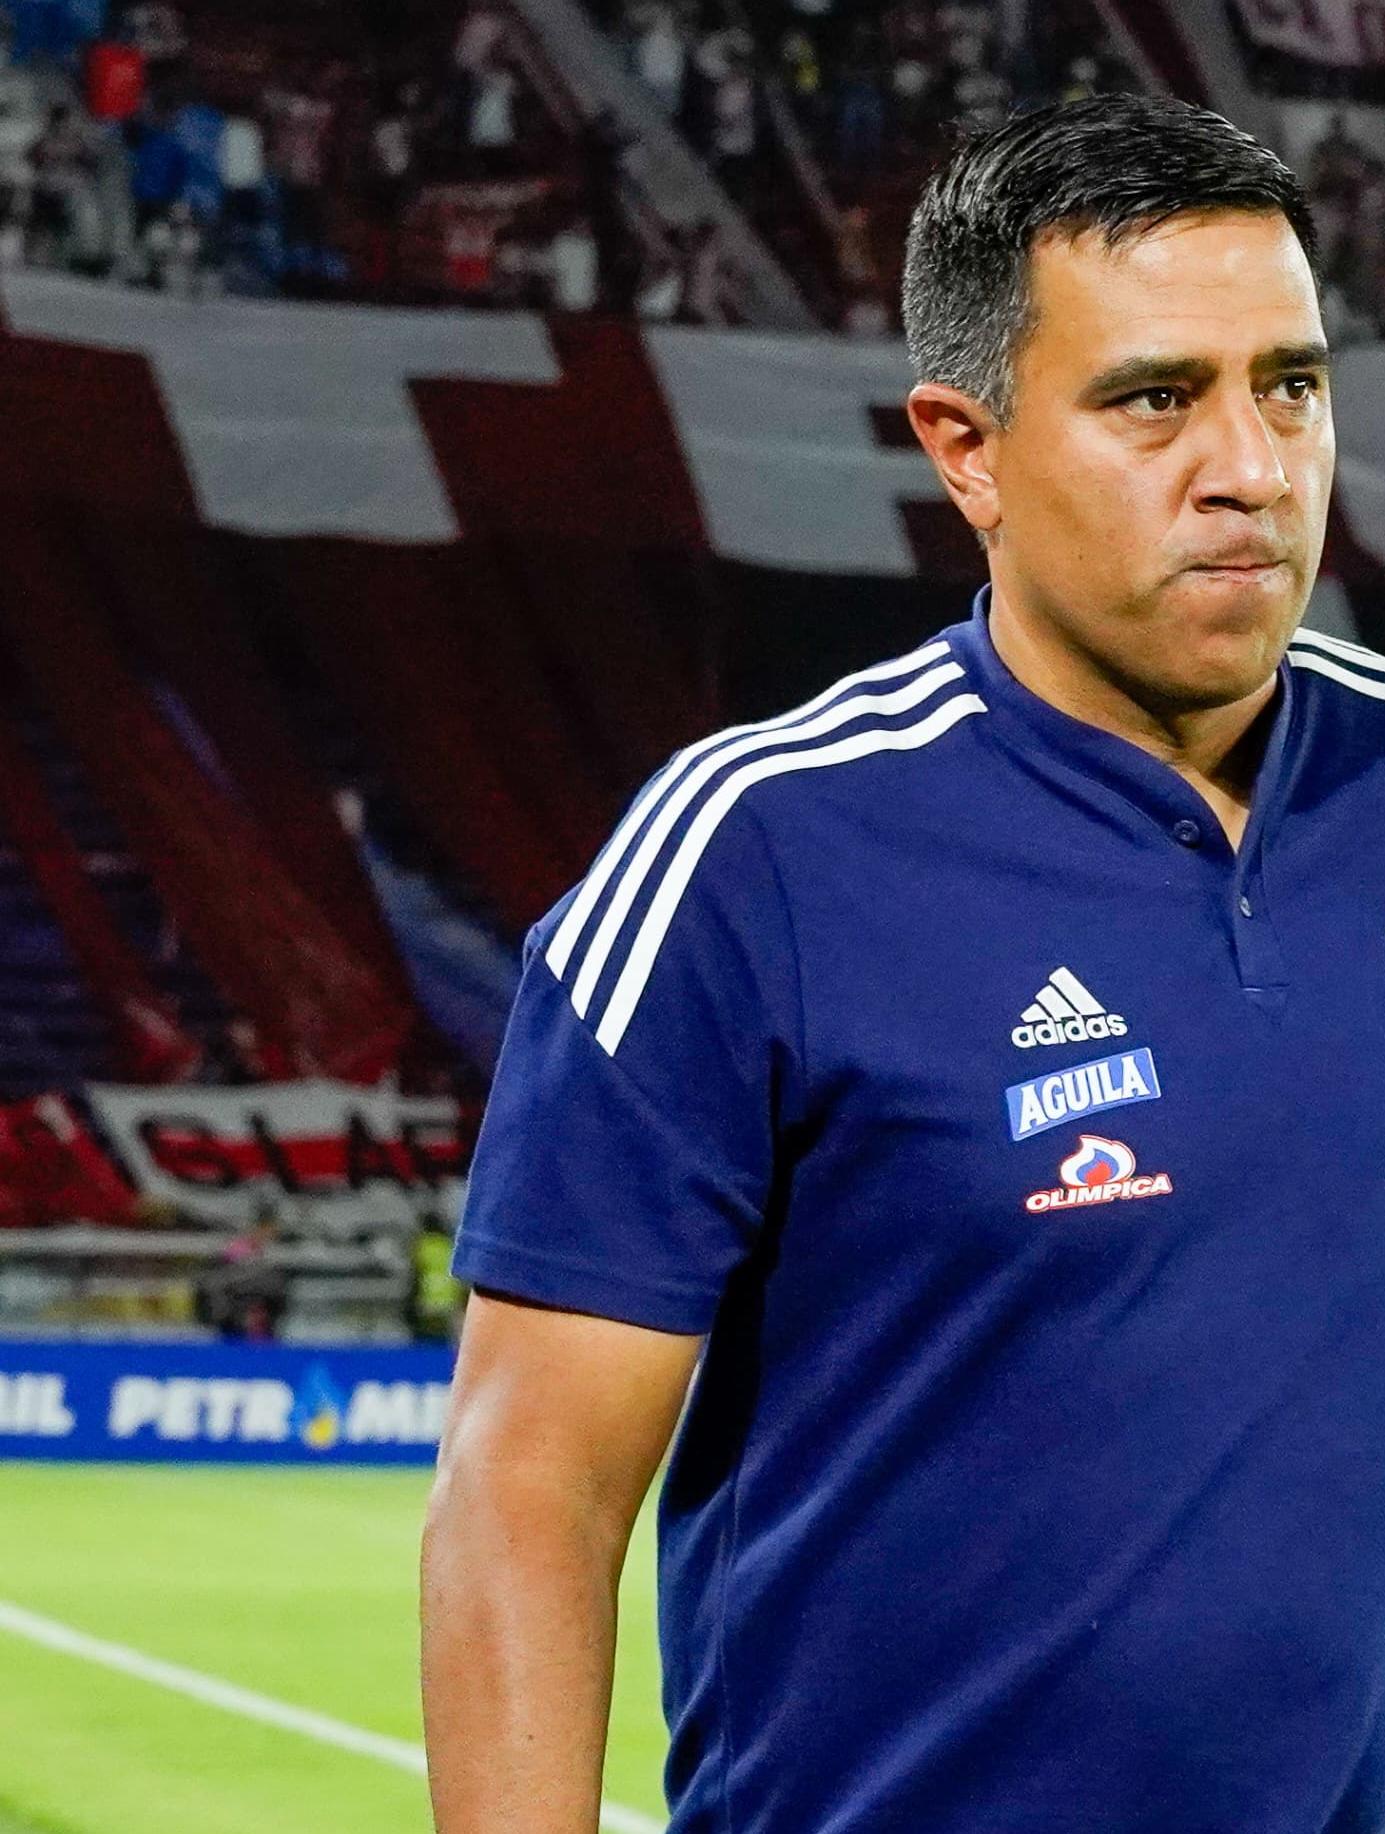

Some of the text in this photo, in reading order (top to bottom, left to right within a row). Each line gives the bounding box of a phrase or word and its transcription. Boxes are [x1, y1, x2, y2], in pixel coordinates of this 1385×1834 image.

[1011, 1010, 1128, 1048] adidas
[1019, 1055, 1151, 1134] AGUILA
[1025, 1174, 1172, 1212] OLIMPICA
